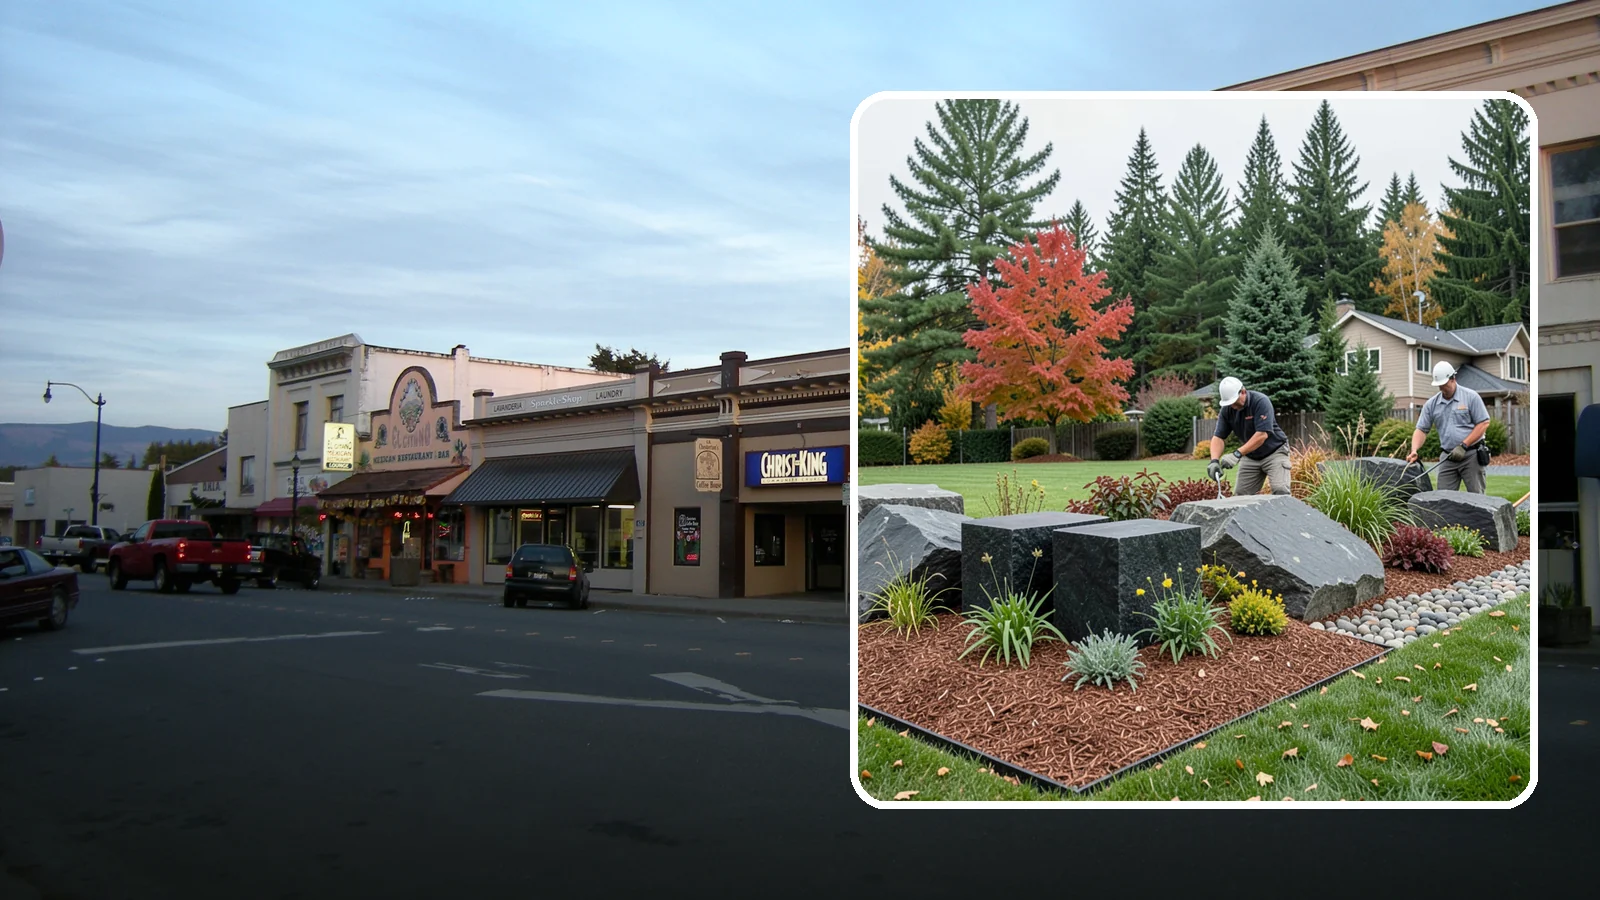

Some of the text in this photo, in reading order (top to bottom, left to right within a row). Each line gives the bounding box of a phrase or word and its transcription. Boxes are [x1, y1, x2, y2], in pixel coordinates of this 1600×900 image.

[596, 389, 623, 400] LAUNDRY
[562, 395, 582, 405] Shop
[493, 402, 522, 412] LAVANDERIA
[397, 452, 433, 462] RESTAURANT
[438, 450, 449, 459] BAR
[761, 450, 827, 477] CHRIST KING
[696, 481, 722, 489] Coffee House
